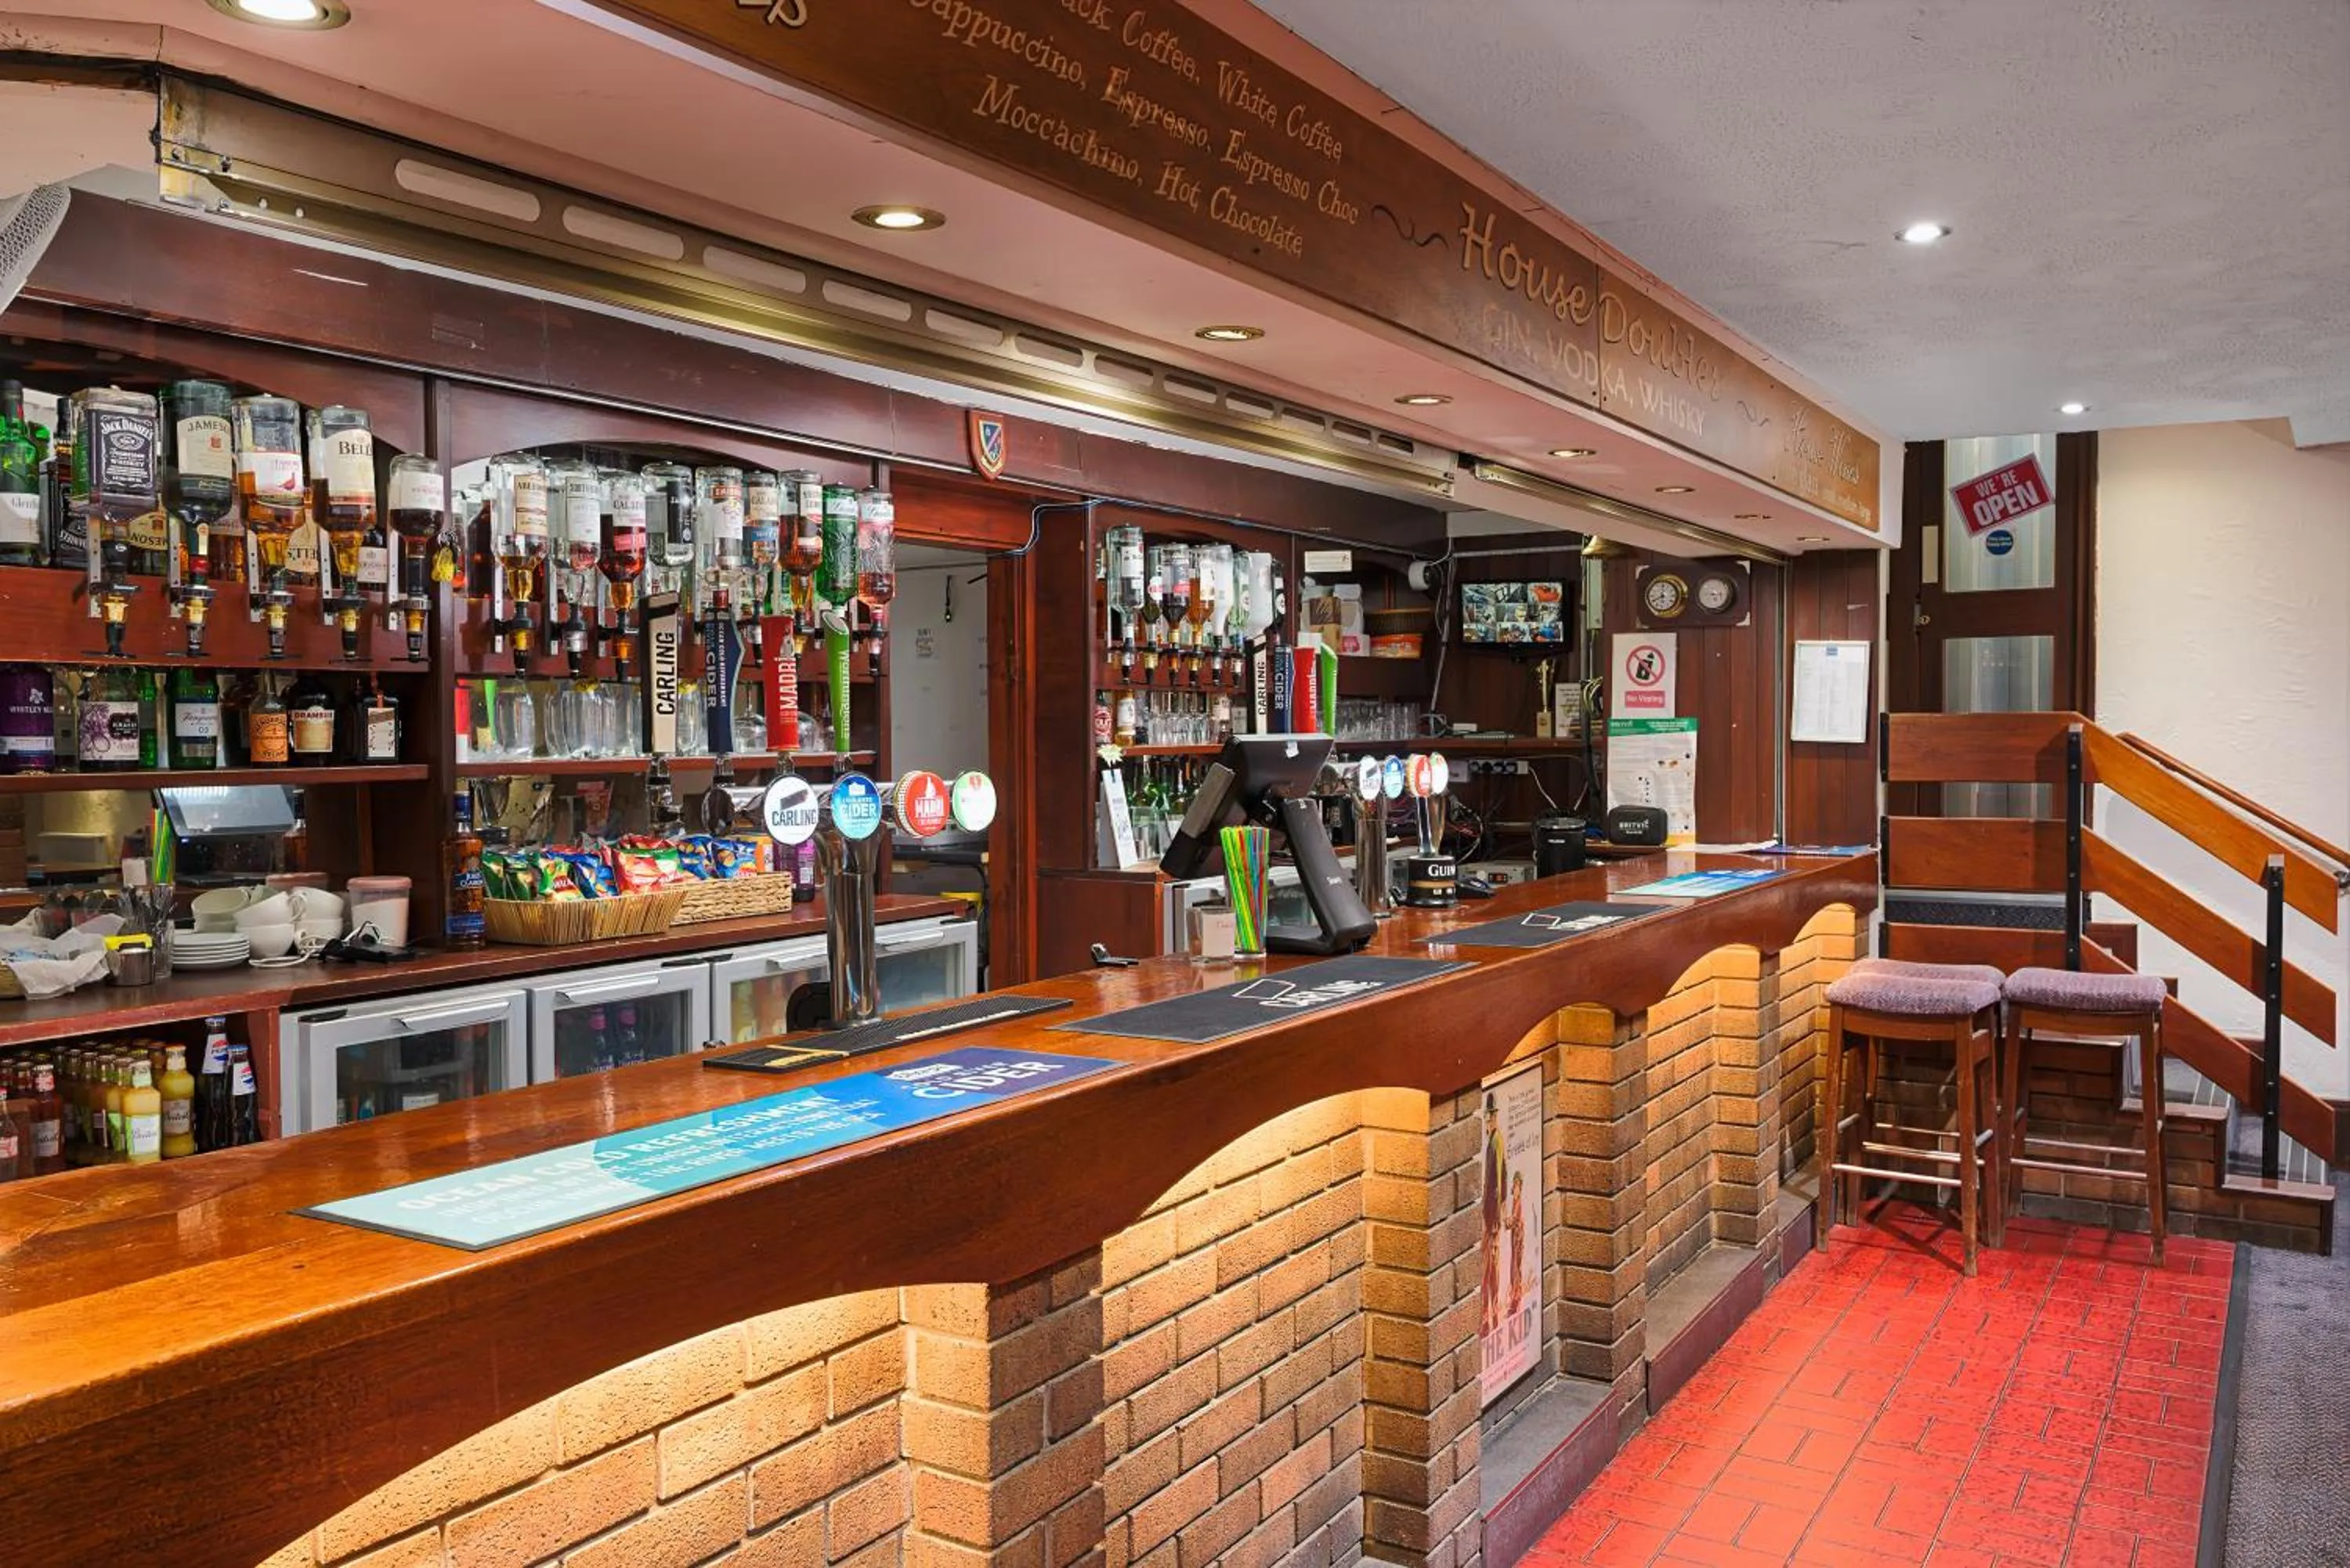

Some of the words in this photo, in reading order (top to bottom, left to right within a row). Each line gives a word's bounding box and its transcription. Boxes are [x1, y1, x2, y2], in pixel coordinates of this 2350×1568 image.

[909, 0, 1086, 91] appuccino,
[1101, 65, 1212, 154] Espresso,
[1220, 128, 1311, 201] Espresso
[1318, 180, 1359, 225] Choc
[1123, 11, 1200, 84] Coffee,
[1217, 61, 1278, 127] White
[1287, 105, 1343, 163] Coffee
[1154, 161, 1202, 213] Hot
[1210, 186, 1303, 258] Chocolate
[1460, 201, 1596, 326] House
[1546, 329, 1635, 409] VODKA,
[1638, 379, 1706, 436] WHISKY
[1973, 480, 2040, 527] OPEN
[1975, 469, 2019, 498] WE'RE
[656, 631, 674, 716] CARLING
[706, 652, 716, 707] CIDER
[1274, 674, 1284, 710] CIDER
[772, 807, 817, 827] CARLING
[839, 803, 877, 819] CIDER
[912, 1060, 1065, 1098] CIDER
[398, 1175, 539, 1209] OCEAN
[533, 1151, 631, 1176] COLD
[624, 1097, 841, 1151] REFRESHMENT
